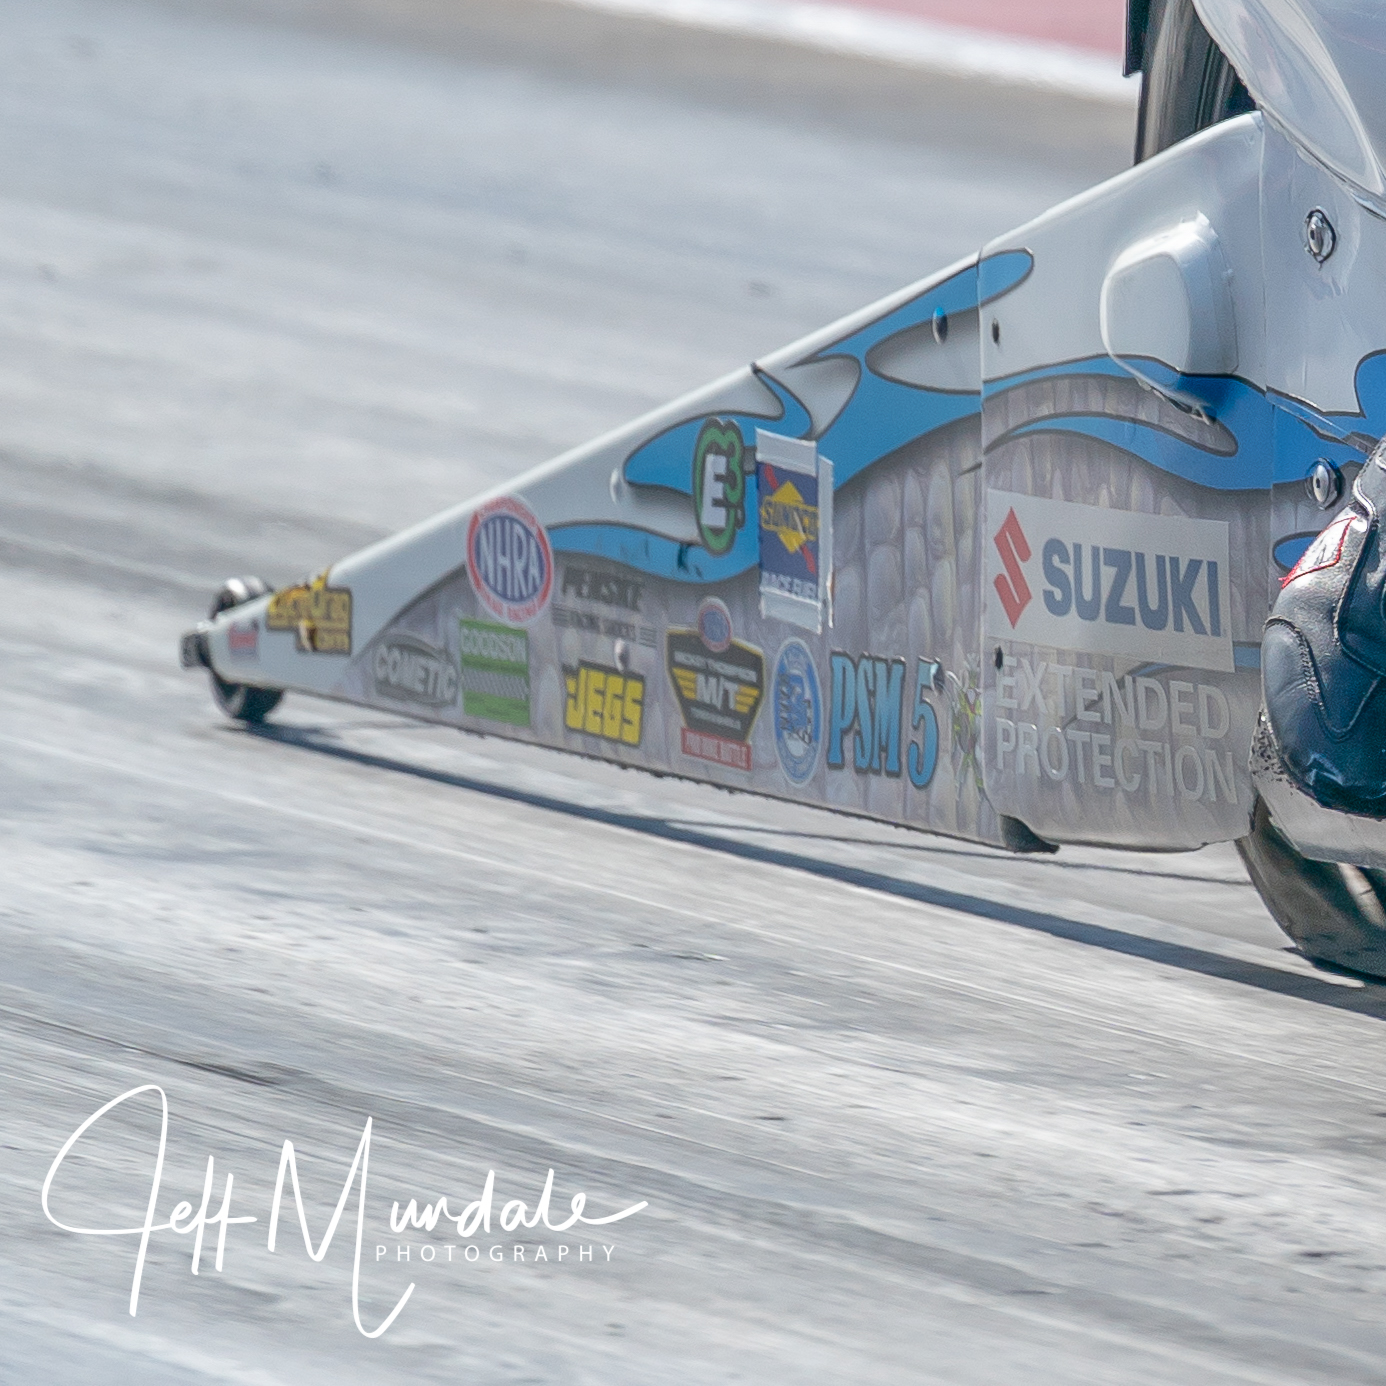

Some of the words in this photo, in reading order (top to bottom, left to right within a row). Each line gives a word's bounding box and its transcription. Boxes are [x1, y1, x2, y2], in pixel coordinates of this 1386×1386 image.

[477, 516, 545, 603] NHRA
[1041, 536, 1222, 639] SUZUKI
[565, 666, 645, 746] JEGS
[827, 649, 905, 777] PSM
[906, 656, 941, 789] 5
[998, 656, 1231, 739] EXTENDED
[995, 717, 1239, 805] PROTECTION
